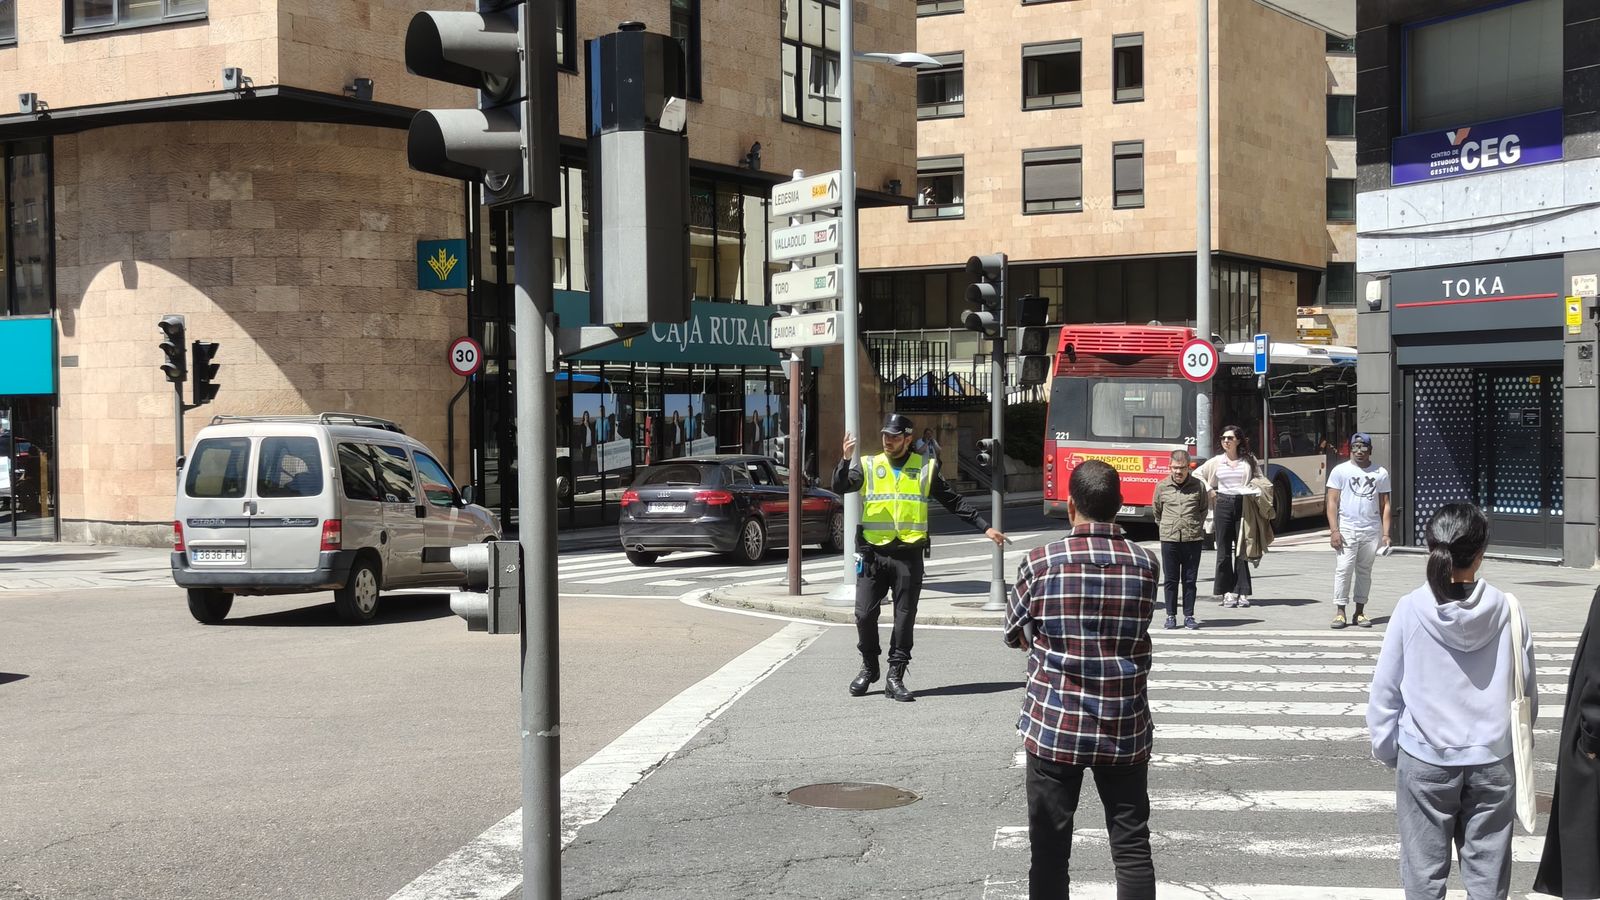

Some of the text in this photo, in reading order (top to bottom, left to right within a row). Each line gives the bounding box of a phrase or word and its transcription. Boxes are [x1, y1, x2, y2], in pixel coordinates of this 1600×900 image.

[1430, 148, 1460, 159] CENTRO DE
[1460, 134, 1521, 171] CEG
[1430, 157, 1460, 168] ESTUDIOS
[1430, 165, 1460, 176] GESTIÓN
[774, 189, 800, 206] LEDESMA
[774, 233, 807, 250] VALLADOLID
[775, 281, 789, 295] TORO
[1442, 276, 1505, 297] TOKA
[651, 313, 703, 352] CAJA
[774, 326, 796, 339] ZAMORA
[456, 349, 474, 362] 30
[1187, 352, 1209, 367] 30
[1055, 431, 1070, 440] 221
[1184, 436, 1197, 445] 22
[1086, 454, 1140, 464] TRANSPORTE
[199, 549, 223, 560] 3836
